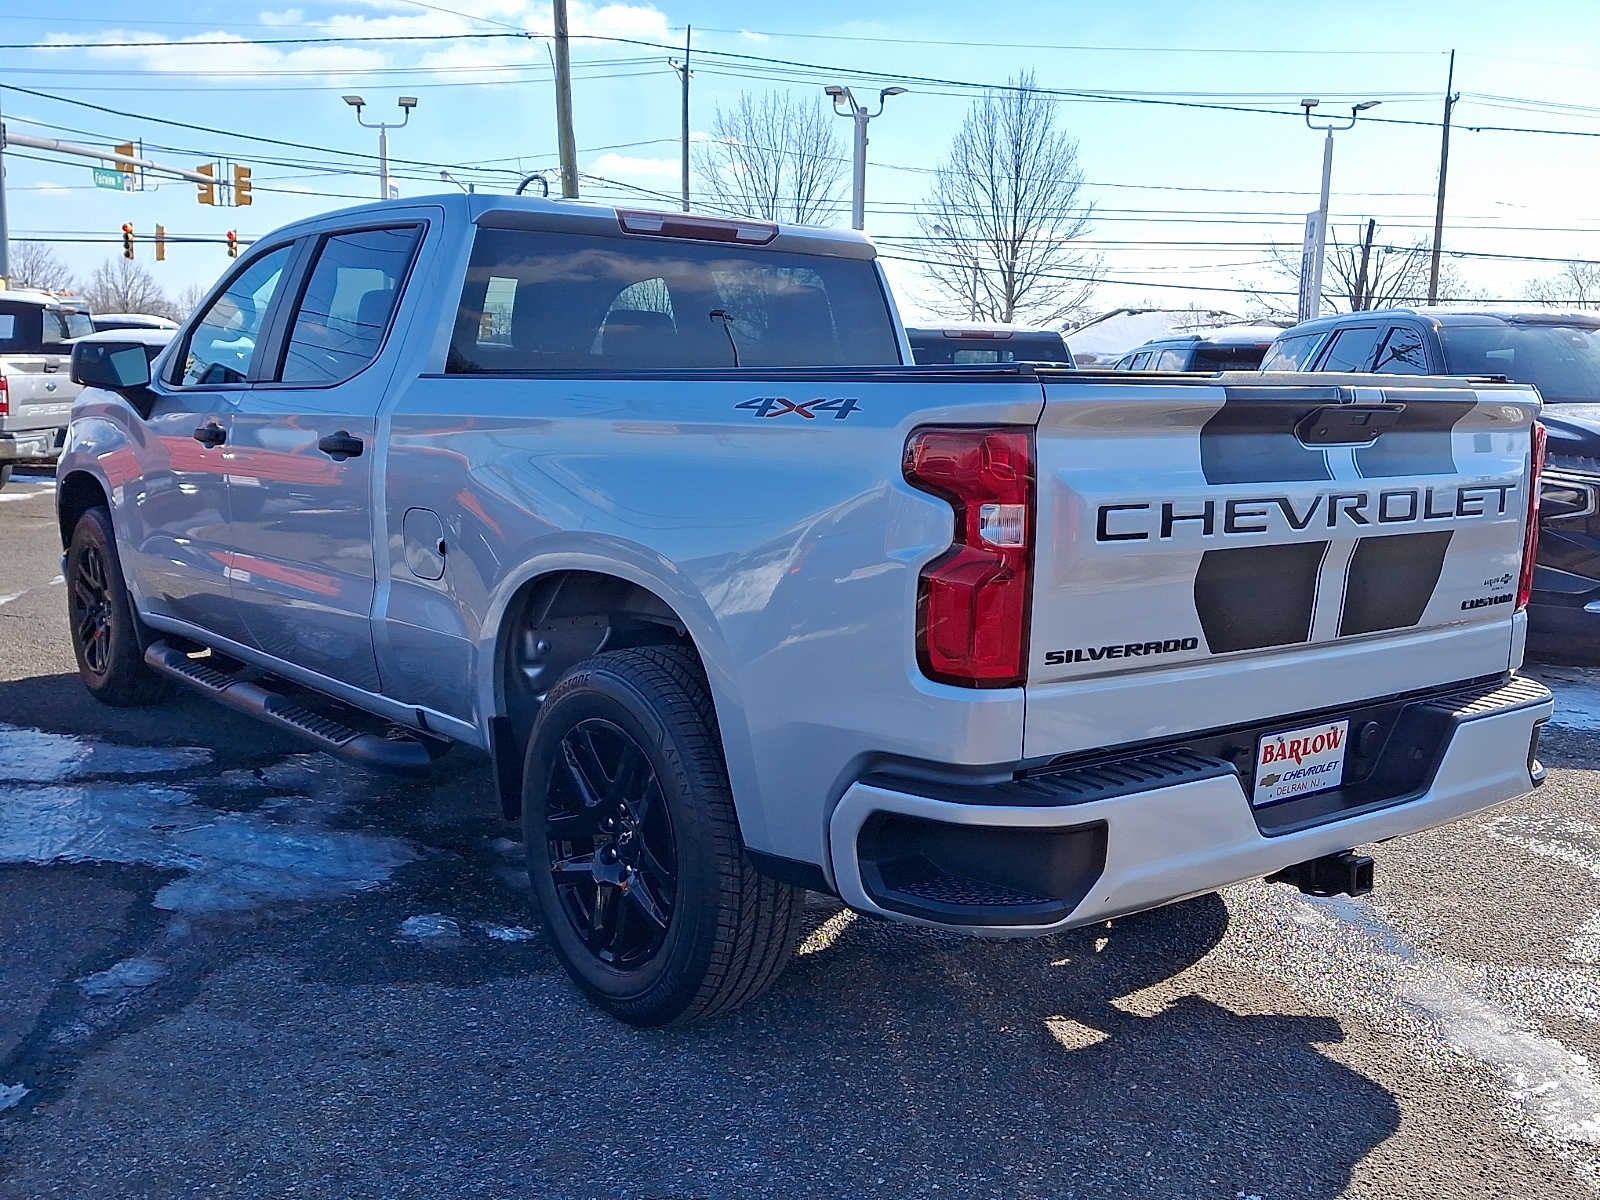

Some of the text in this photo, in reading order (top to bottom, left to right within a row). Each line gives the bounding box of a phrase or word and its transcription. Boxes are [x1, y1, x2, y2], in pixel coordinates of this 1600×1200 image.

[1096, 483, 1517, 543] CHEVROLET
[1461, 593, 1513, 610] CUSTOM
[1044, 637, 1199, 666] SILVERADO
[1261, 729, 1344, 765] BARLOW
[1282, 760, 1340, 781] CHEVROLET
[1276, 779, 1321, 796] DELRAN NJ
